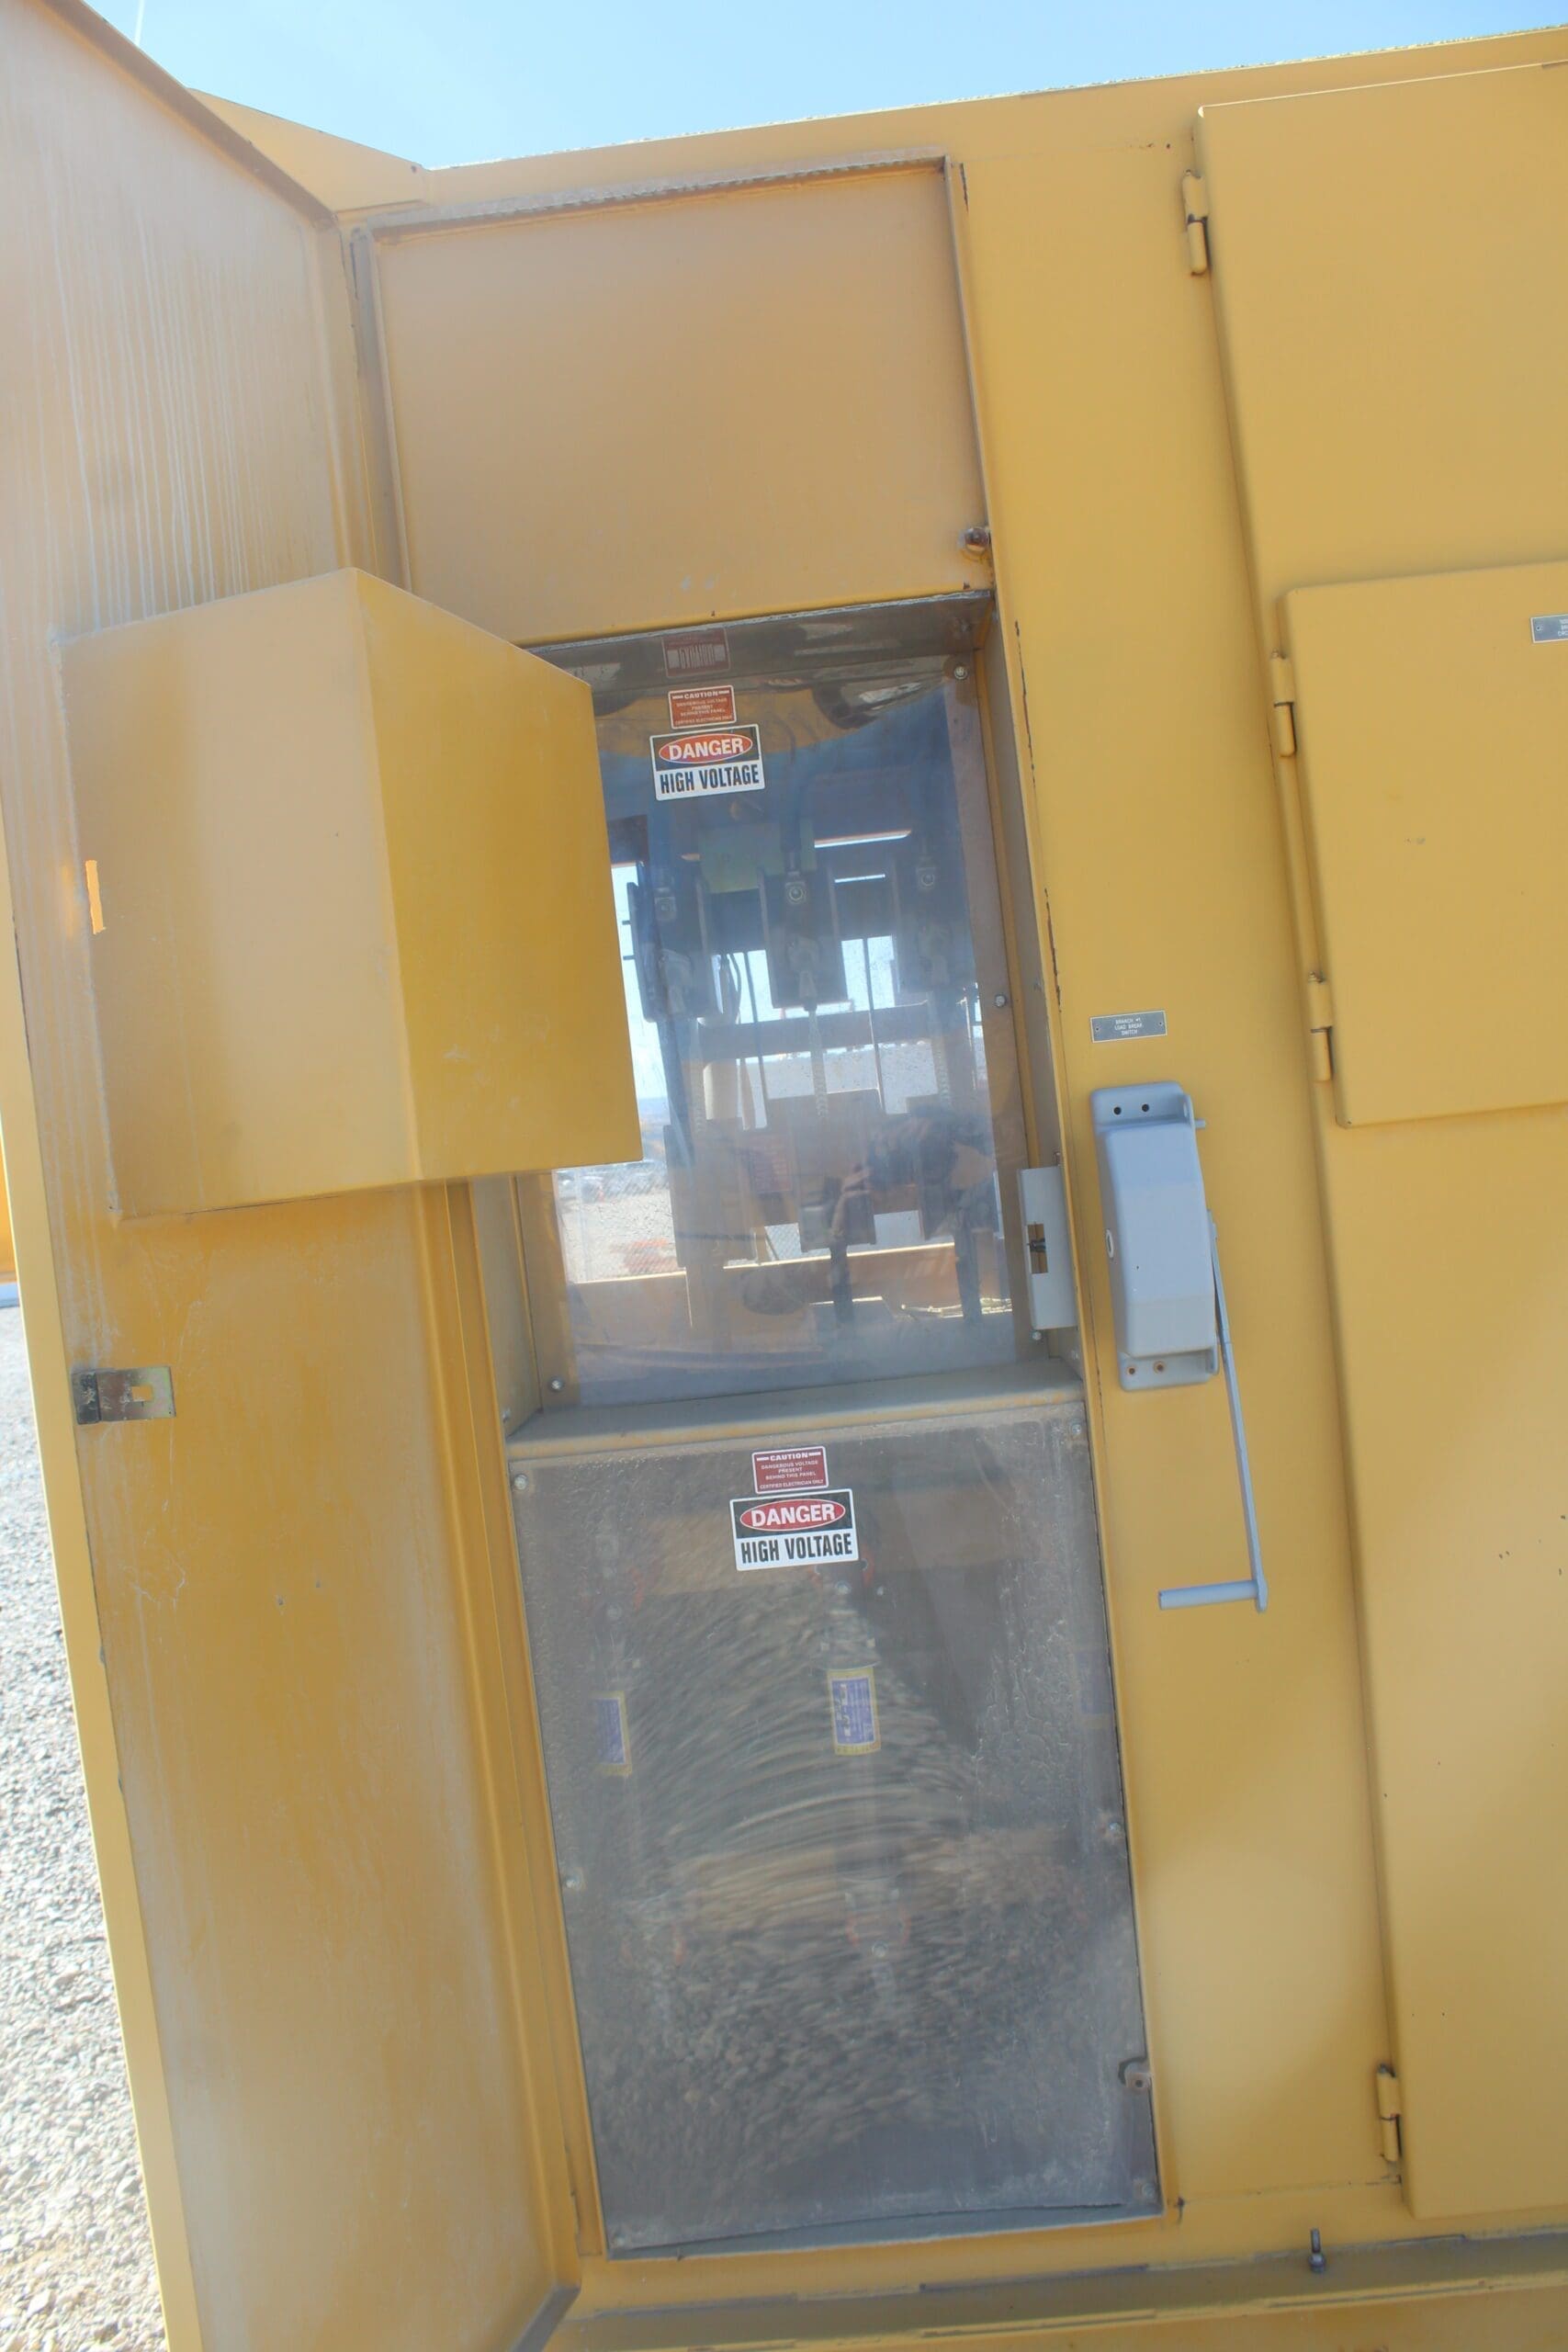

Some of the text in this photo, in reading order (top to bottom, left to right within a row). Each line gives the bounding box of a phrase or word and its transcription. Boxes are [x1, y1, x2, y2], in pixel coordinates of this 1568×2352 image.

[684, 691, 718, 699] CAUTION
[669, 737, 745, 761] DANGER
[660, 763, 759, 795] HIGH VOLTAGE
[761, 1462, 795, 1470] DANGEROUS
[770, 1452, 808, 1461] CAUTION
[750, 1503, 835, 1527] DANGER
[740, 1532, 852, 1564] HIGH VOLTAGE
